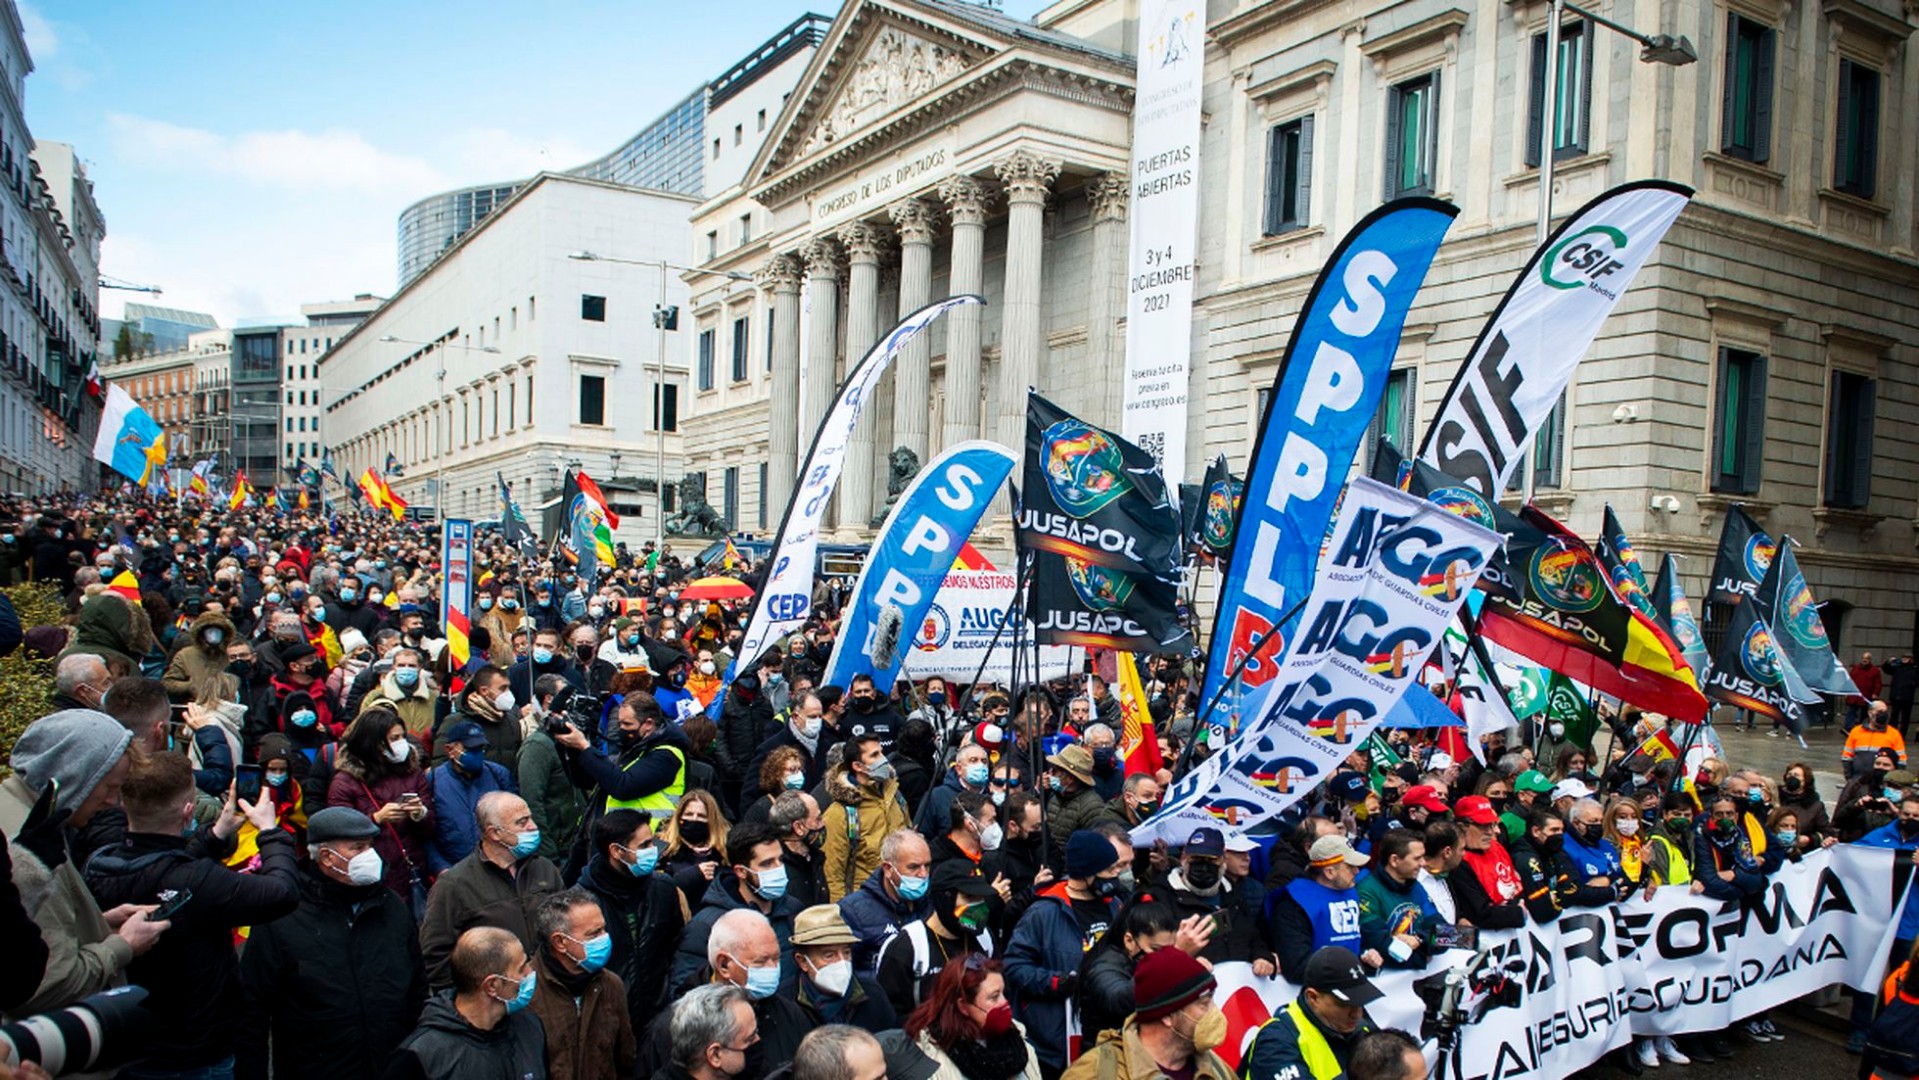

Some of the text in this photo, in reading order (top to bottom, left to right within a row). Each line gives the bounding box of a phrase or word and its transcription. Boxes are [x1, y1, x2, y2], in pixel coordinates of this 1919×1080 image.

[1138, 145, 1191, 177] PUERTAS
[819, 149, 945, 218] CONGRESO DE LOS DIPUTADOS
[1137, 170, 1192, 200] ABIERTAS
[1145, 245, 1172, 267] 3 y 4
[1562, 242, 1625, 283] CSIF
[1131, 264, 1192, 294] DICIEMBRE
[1588, 280, 1617, 301] Madrid
[1143, 293, 1170, 313] 2021
[1019, 509, 1144, 563] JUSAPOL
[1384, 579, 1423, 607] GUARDIAS
[1329, 656, 1368, 682] GUARDIAS
[1368, 678, 1396, 695] CIVILES
[1310, 740, 1339, 758] CIVILES
